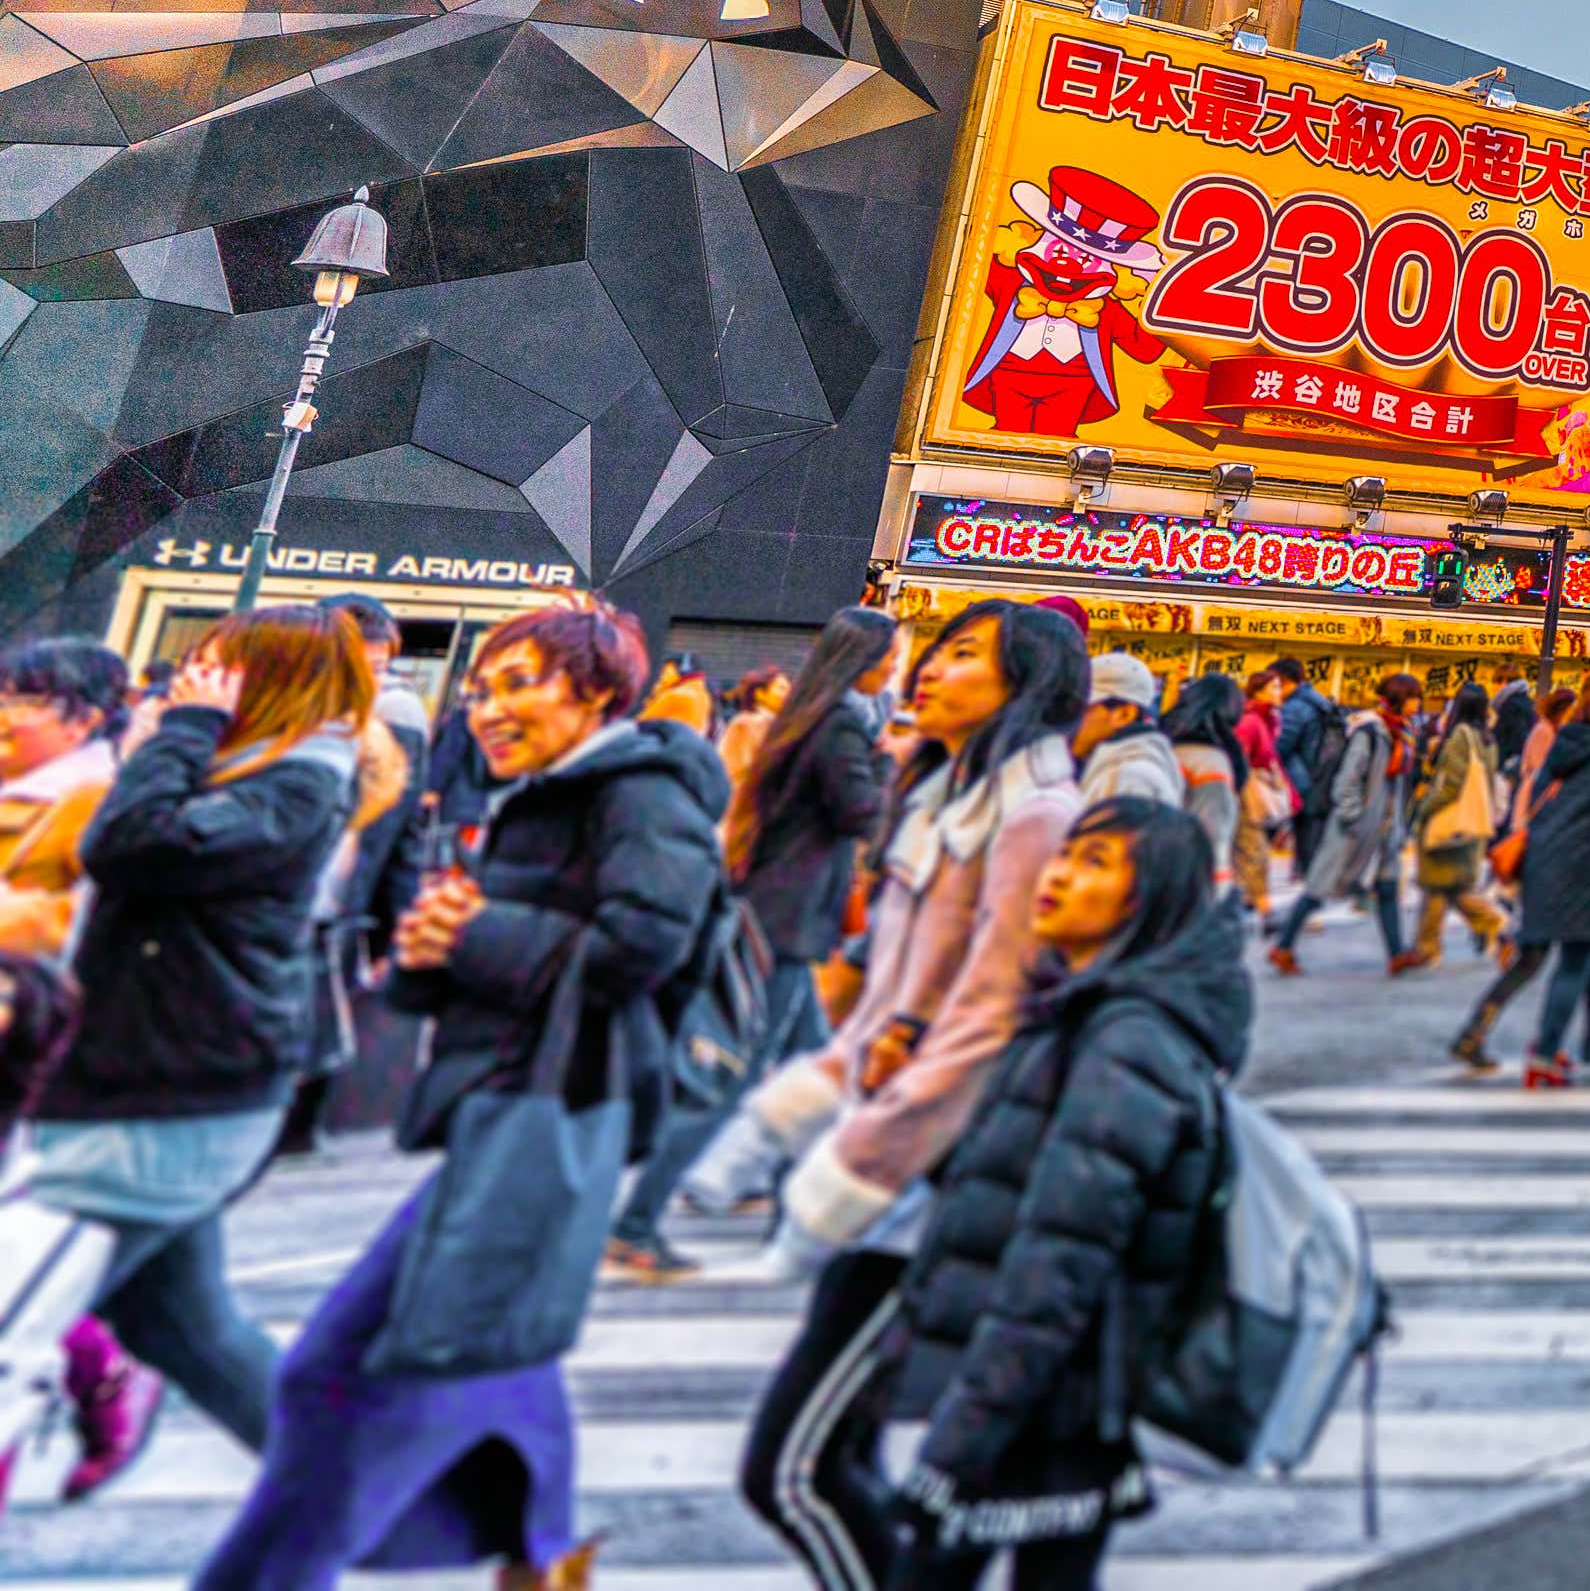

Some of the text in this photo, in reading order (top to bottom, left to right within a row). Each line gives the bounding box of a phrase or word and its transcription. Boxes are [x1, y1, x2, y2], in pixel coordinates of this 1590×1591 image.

[1523, 354, 1587, 385] OVER
[1253, 370, 1473, 435] 渋谷地区合計
[387, 555, 574, 586] ARMOUR
[1208, 615, 1346, 636] 無双 NEXT STAGE
[1402, 628, 1525, 647] 無双 NEXT STAGE
